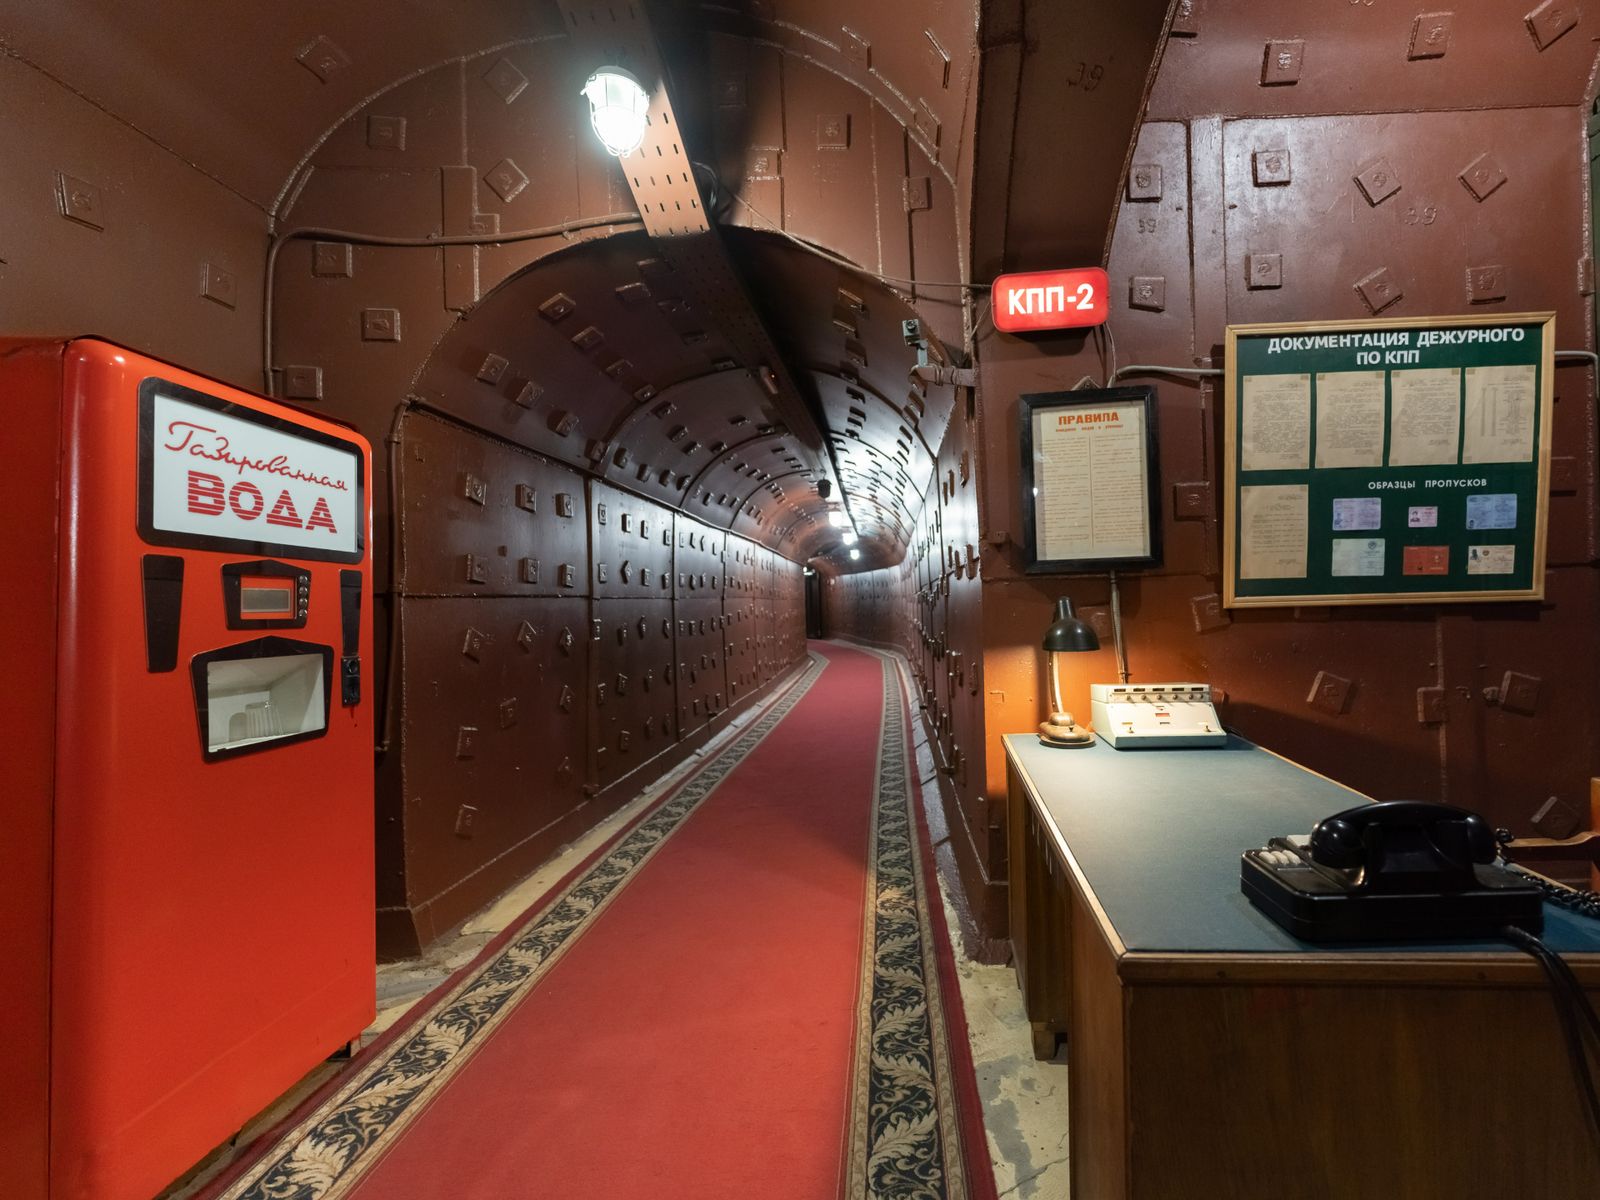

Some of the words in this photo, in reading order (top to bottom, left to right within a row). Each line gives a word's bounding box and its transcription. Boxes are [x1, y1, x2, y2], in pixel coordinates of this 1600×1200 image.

[1008, 283, 1094, 315] КПП-2
[1267, 332, 1409, 354] ДОКУМЕНТАЦИЯ
[1416, 328, 1525, 347] ДЕЖУРНОГО
[1356, 351, 1381, 365] ПО
[1385, 349, 1420, 364] КПП
[1058, 411, 1119, 425] ПРАВИЛА
[1368, 480, 1416, 489] ОБРАЗЦЫ
[1425, 478, 1488, 488] ПРОПУСКОВ
[187, 470, 337, 533] ВОДА
